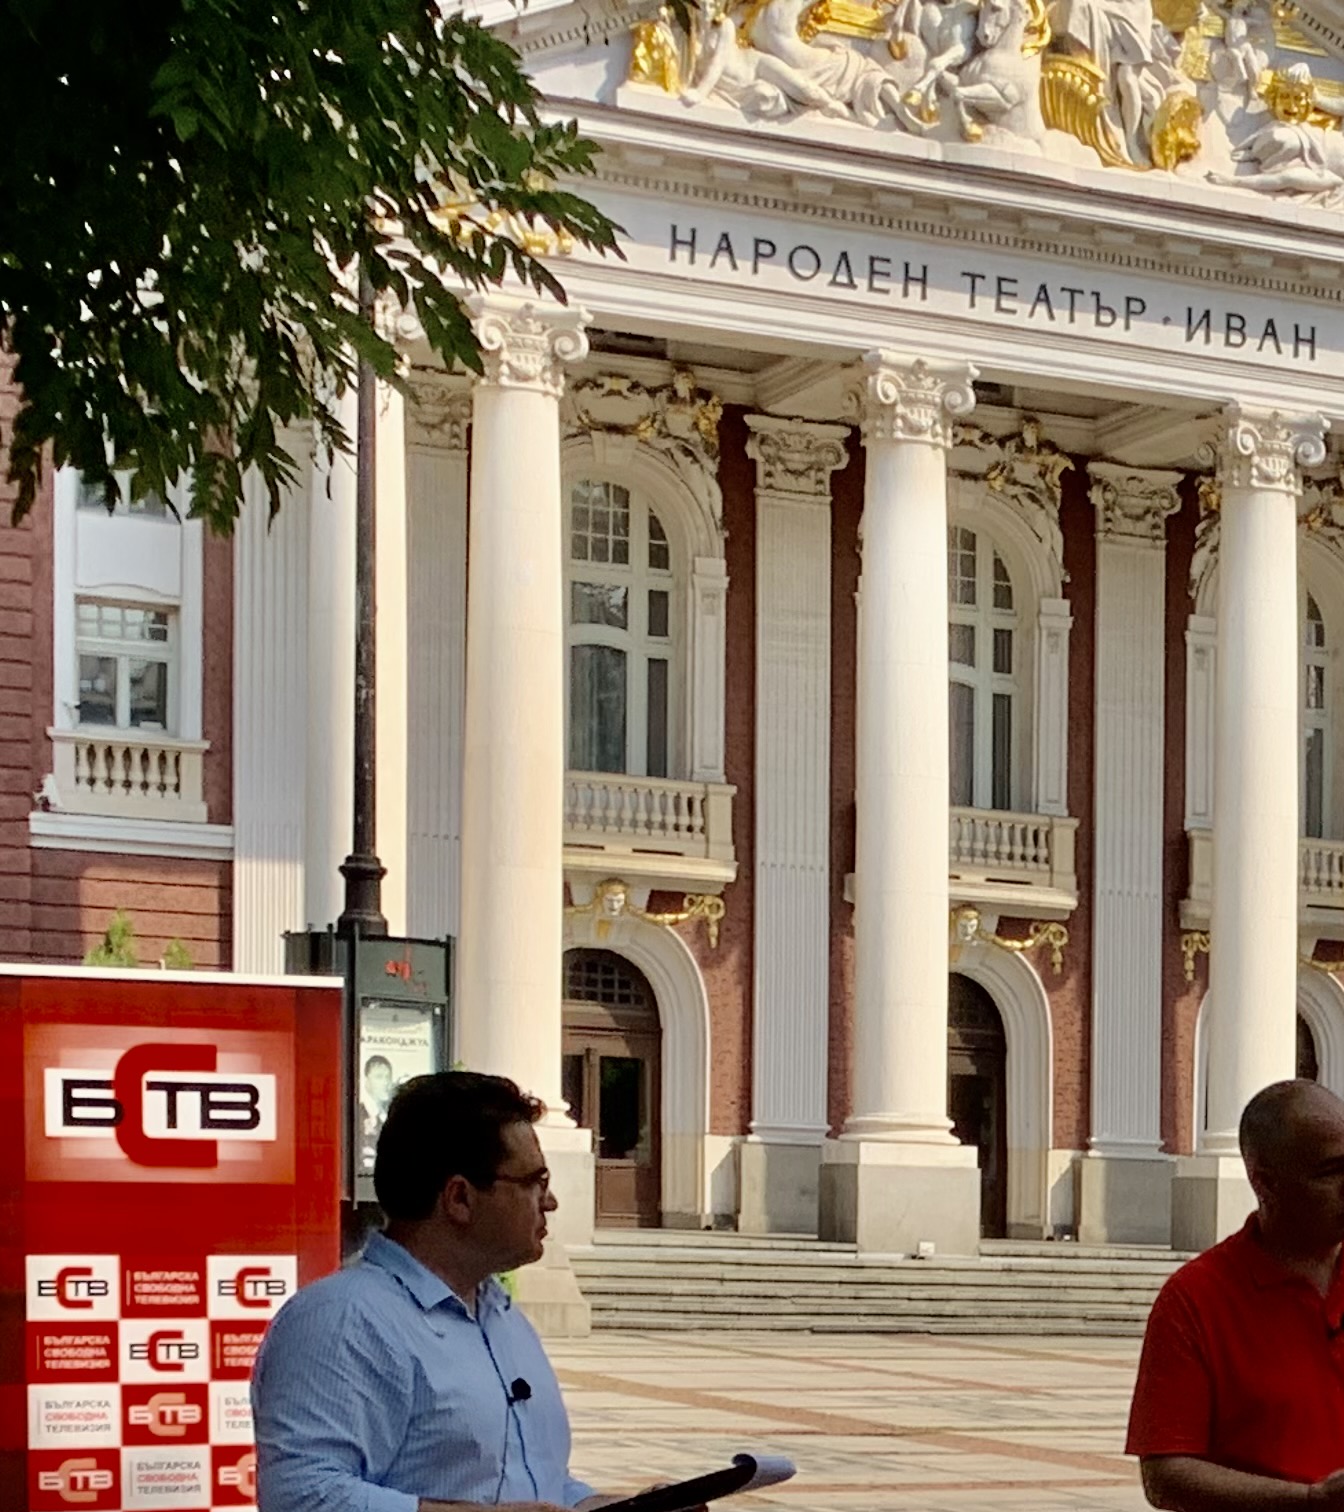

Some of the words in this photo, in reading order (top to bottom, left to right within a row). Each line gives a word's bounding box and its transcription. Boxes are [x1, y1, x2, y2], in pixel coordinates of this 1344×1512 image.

[669, 224, 928, 301] НАРОДЕН
[961, 271, 1147, 331] ТЕАТЪР
[1184, 306, 1316, 361] ИВАН
[45, 1400, 111, 1410] БЪЛГАРСКА
[45, 1411, 108, 1422] СВОБОДНА
[45, 1423, 111, 1434] ТЕЛЕВИЗИЯ
[137, 1461, 201, 1471] БЪЛГАРСКА
[137, 1473, 198, 1483] СВОБОДНА
[137, 1485, 201, 1495] ТЕЛЕВИЗИЯ
